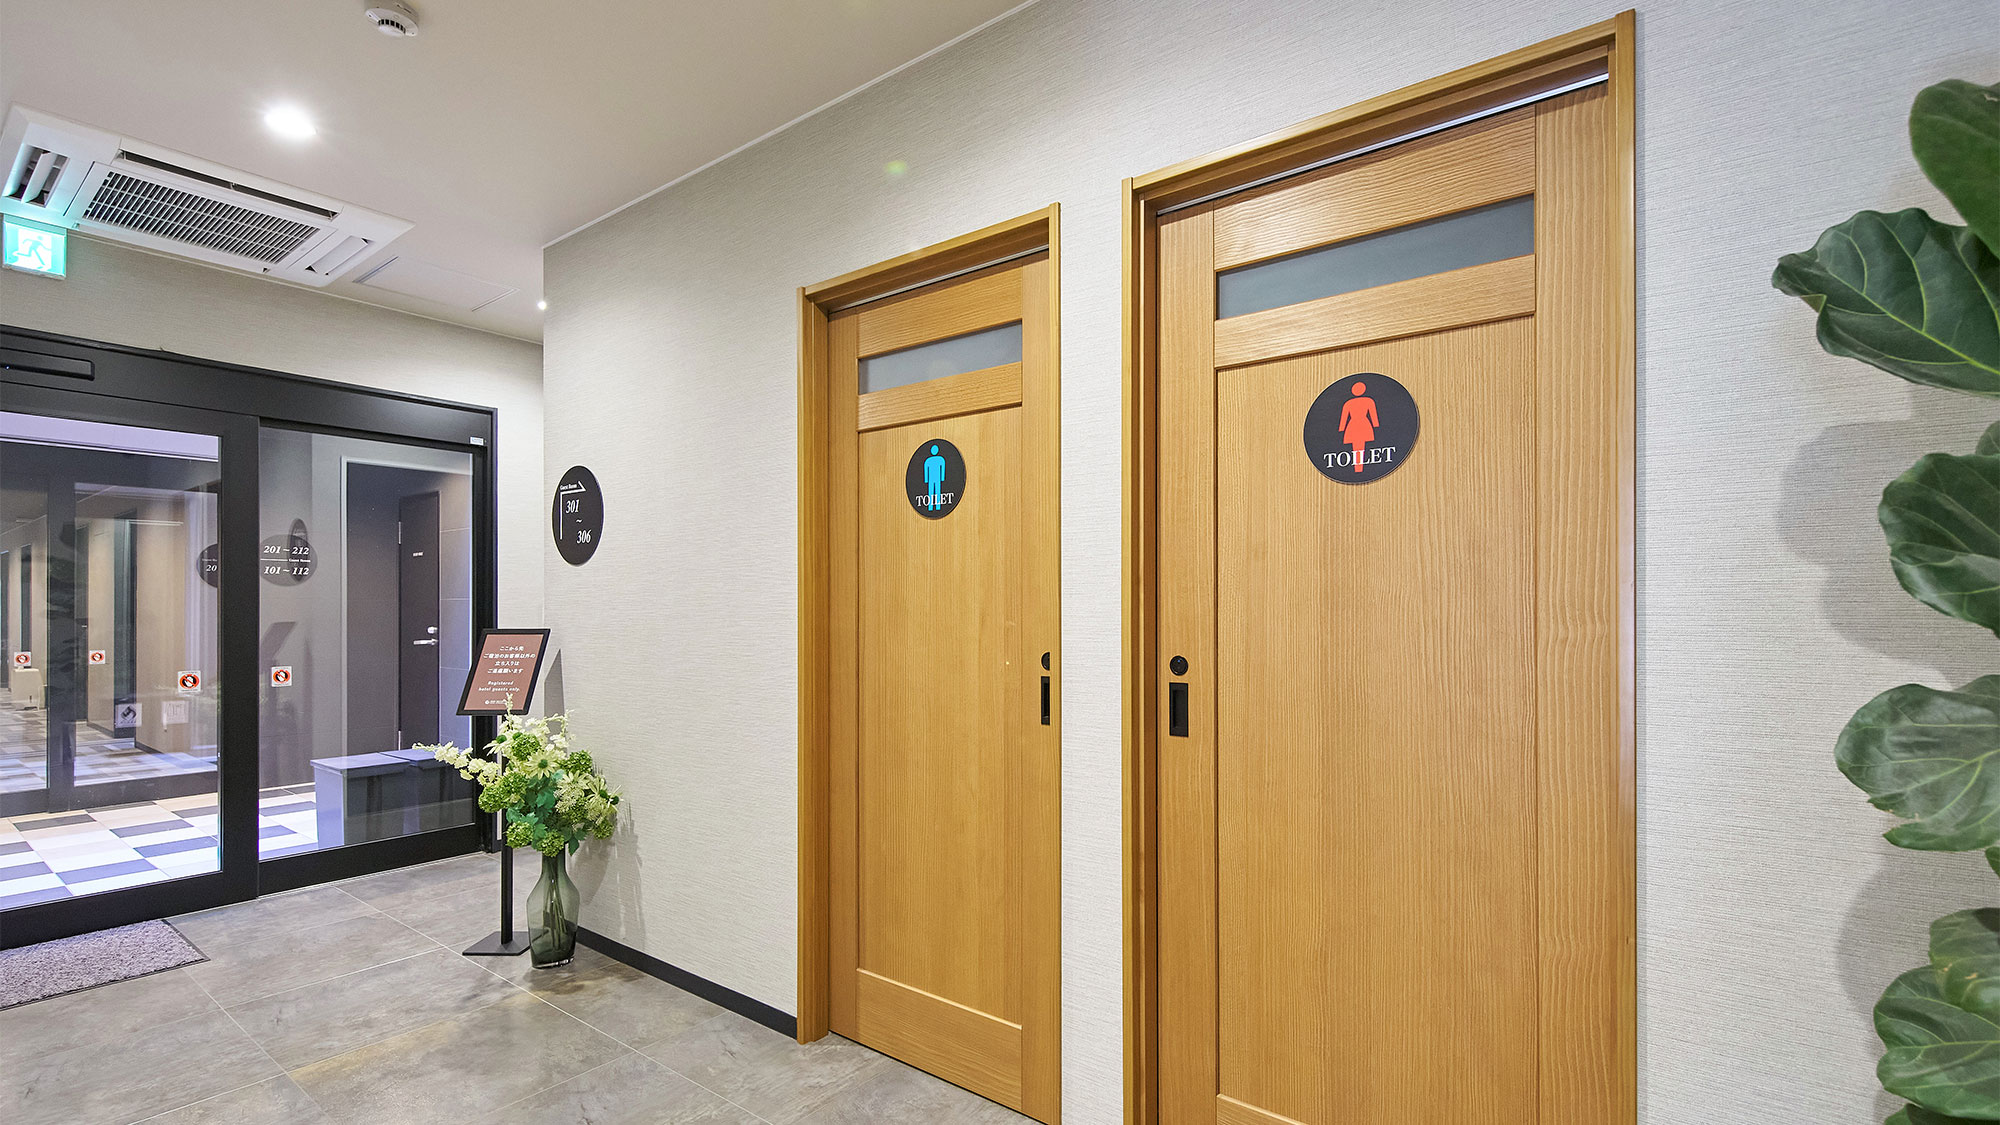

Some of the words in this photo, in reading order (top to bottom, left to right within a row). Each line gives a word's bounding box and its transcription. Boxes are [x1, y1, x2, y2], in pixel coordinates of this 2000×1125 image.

[1323, 446, 1396, 468] TOILET
[565, 499, 580, 514] 301
[915, 492, 955, 507] TOILET
[576, 529, 592, 544] 306
[206, 564, 218, 572] 20
